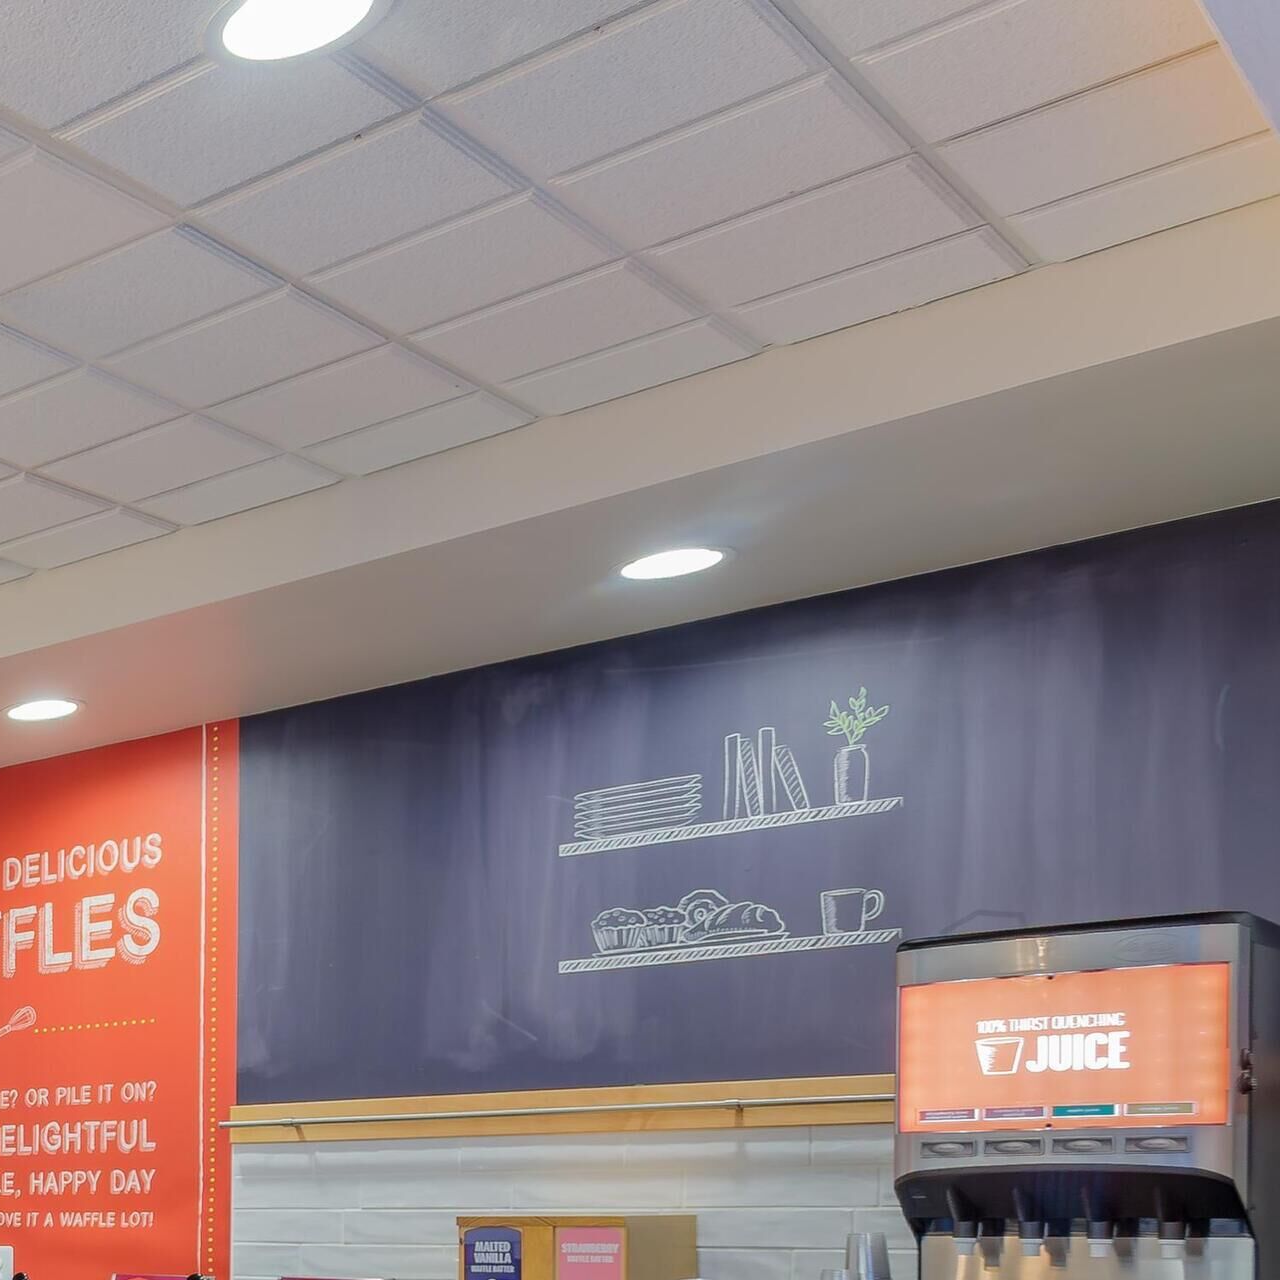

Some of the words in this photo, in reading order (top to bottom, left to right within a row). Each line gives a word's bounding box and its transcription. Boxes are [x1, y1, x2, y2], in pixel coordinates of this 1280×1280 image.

[2, 832, 163, 891] DELICIOUS
[976, 1019, 1007, 1034] 100%
[1007, 1016, 1051, 1032] THIRST
[1051, 1012, 1126, 1030] QUENCHING
[1025, 1030, 1131, 1073] JUICE
[25, 1087, 49, 1107] OR
[55, 1084, 92, 1106] PILE
[98, 1083, 114, 1104] IT
[121, 1080, 158, 1104] ON?
[29, 1169, 102, 1196] HAPPY
[110, 1168, 156, 1195] DAY
[26, 1211, 40, 1228] IT
[43, 1211, 54, 1228] A
[59, 1211, 116, 1228] WAFFLE
[120, 1211, 154, 1228] LOT!
